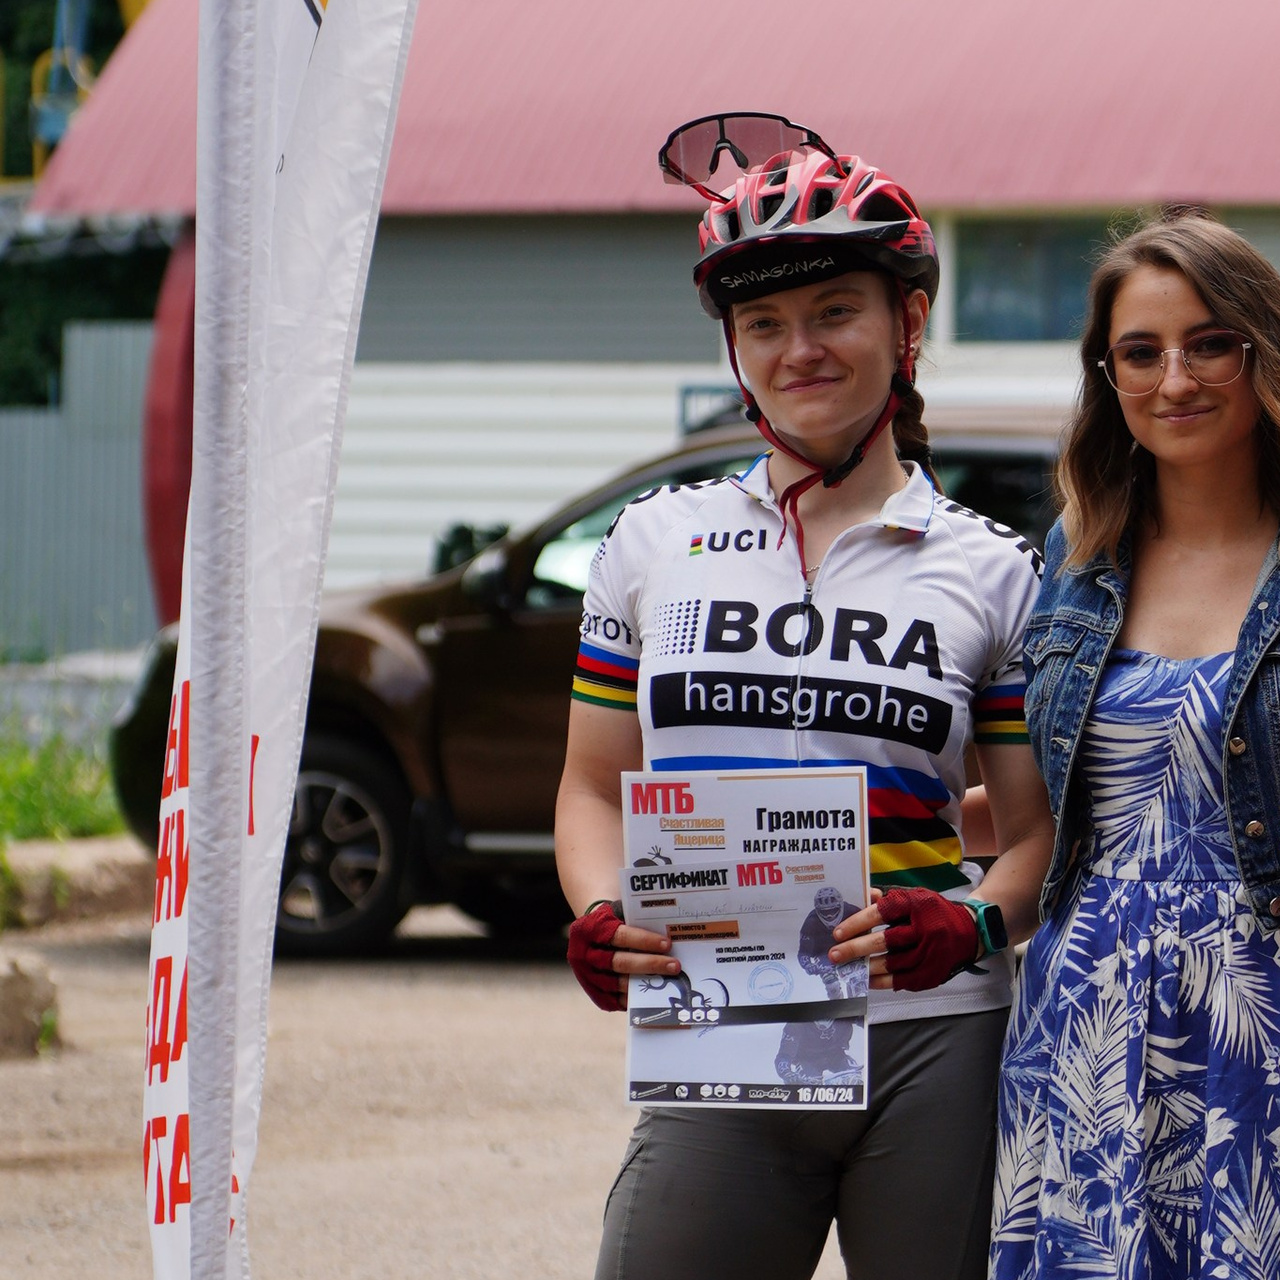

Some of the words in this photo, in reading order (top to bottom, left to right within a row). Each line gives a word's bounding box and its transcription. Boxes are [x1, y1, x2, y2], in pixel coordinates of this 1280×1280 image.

[707, 529, 766, 553] UCI
[703, 600, 943, 682] BORA
[684, 672, 929, 732] hansgrohe
[631, 782, 695, 815] МТБ
[659, 817, 725, 829] Счастливая
[756, 806, 856, 833] Грамота
[674, 834, 725, 847] Ящерица
[743, 837, 856, 854] НАГРАЖДАЕТСЯ
[630, 869, 728, 892] СЕРТИФИКАТ
[736, 861, 783, 887] МТБ
